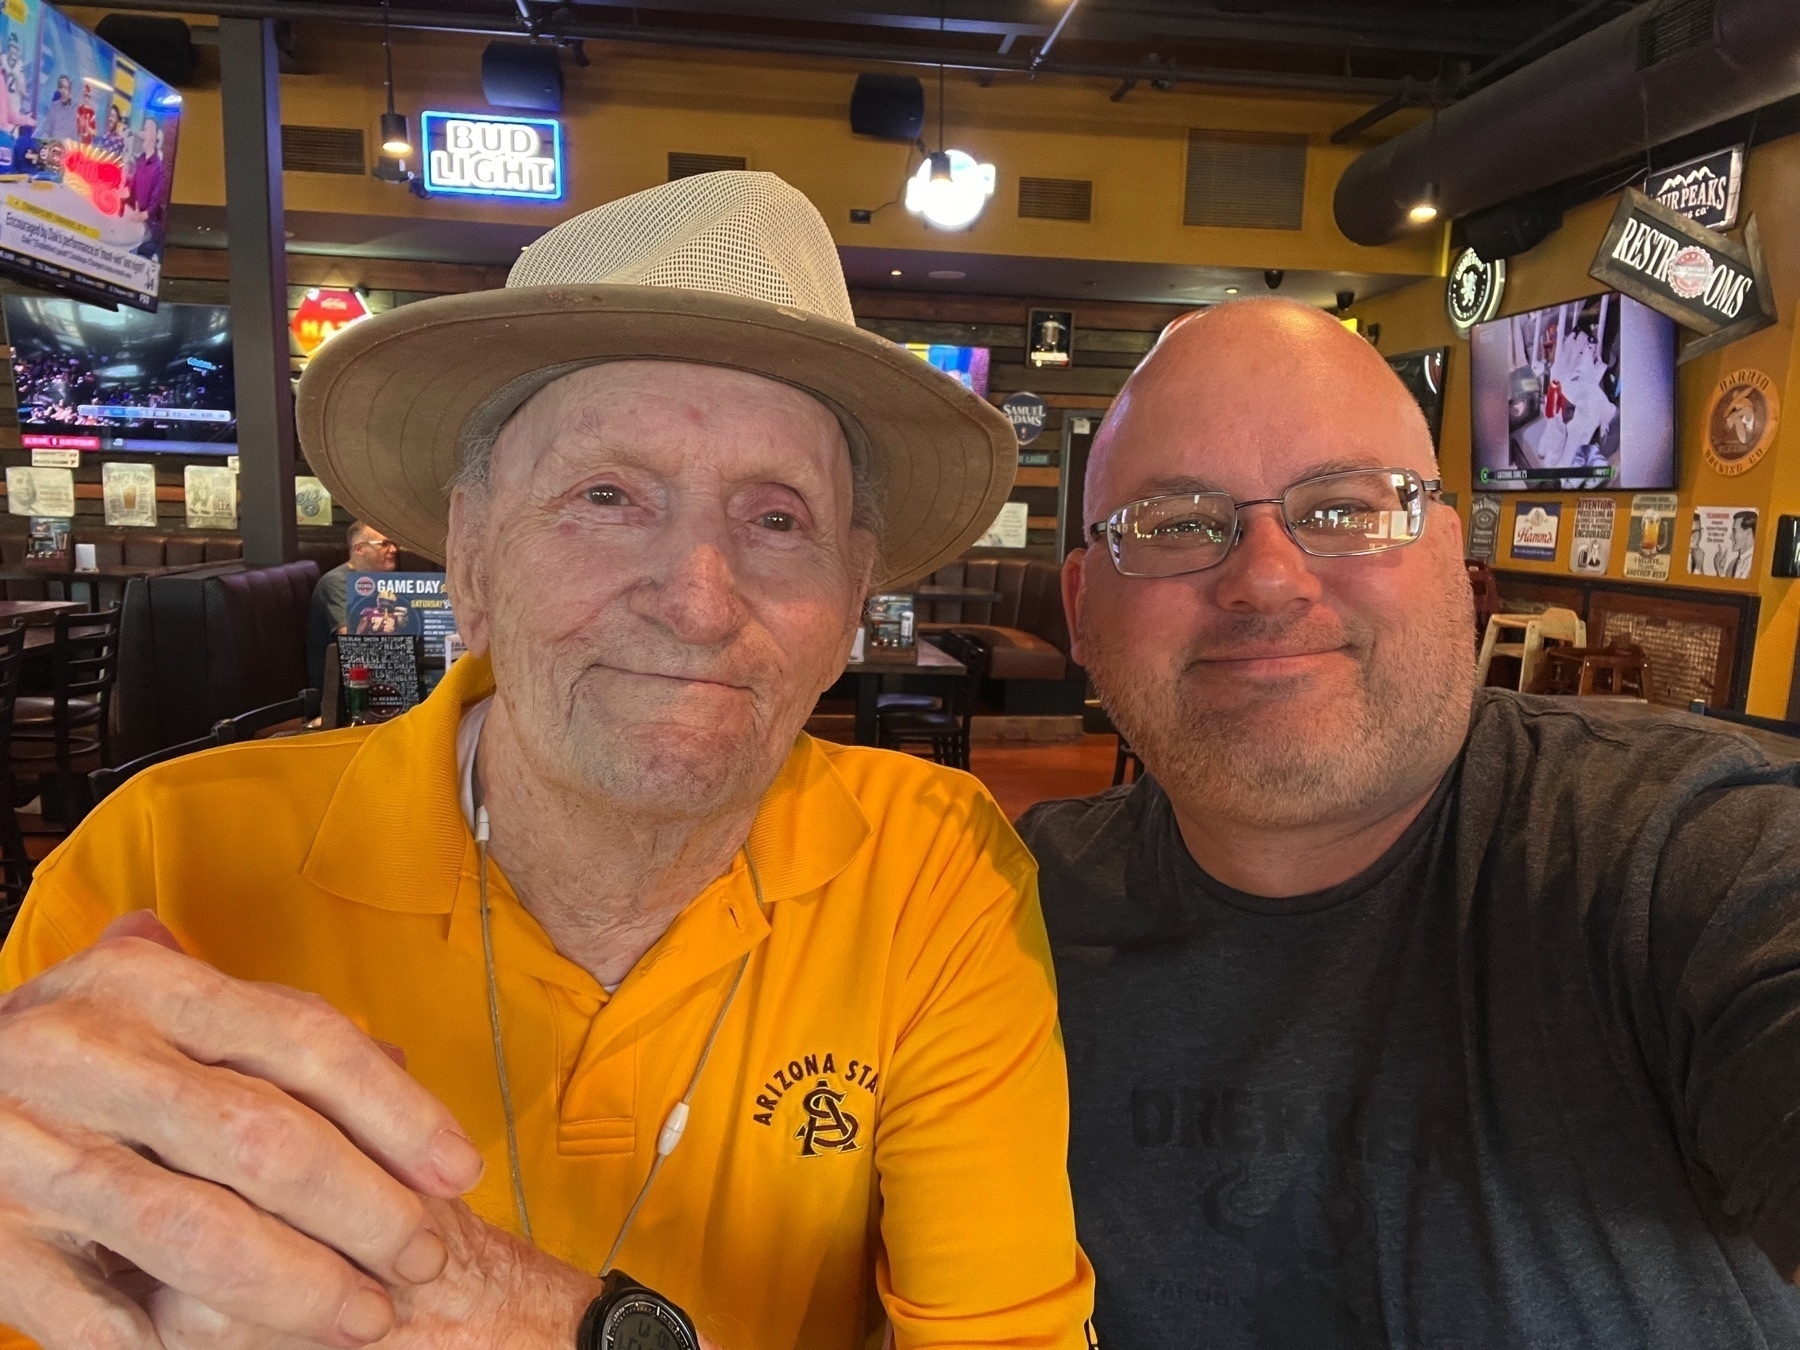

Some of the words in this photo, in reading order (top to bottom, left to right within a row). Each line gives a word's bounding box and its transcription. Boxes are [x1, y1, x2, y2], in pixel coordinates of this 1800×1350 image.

[446, 121, 540, 155] BUD
[430, 151, 555, 191] LIGHT
[1655, 190, 1680, 209] UR
[1680, 176, 1727, 211] PEAKS
[1720, 370, 1770, 392] BARRIO
[1003, 404, 1046, 417] SAMUEL
[1007, 415, 1042, 427] ADAMS
[1704, 448, 1743, 474] BREWING
[377, 580, 413, 593] GAME
[416, 580, 440, 593] DAY
[411, 599, 442, 608] SATURDAY
[752, 1053, 837, 1127] ARIZONA
[844, 1060, 879, 1095] STA
